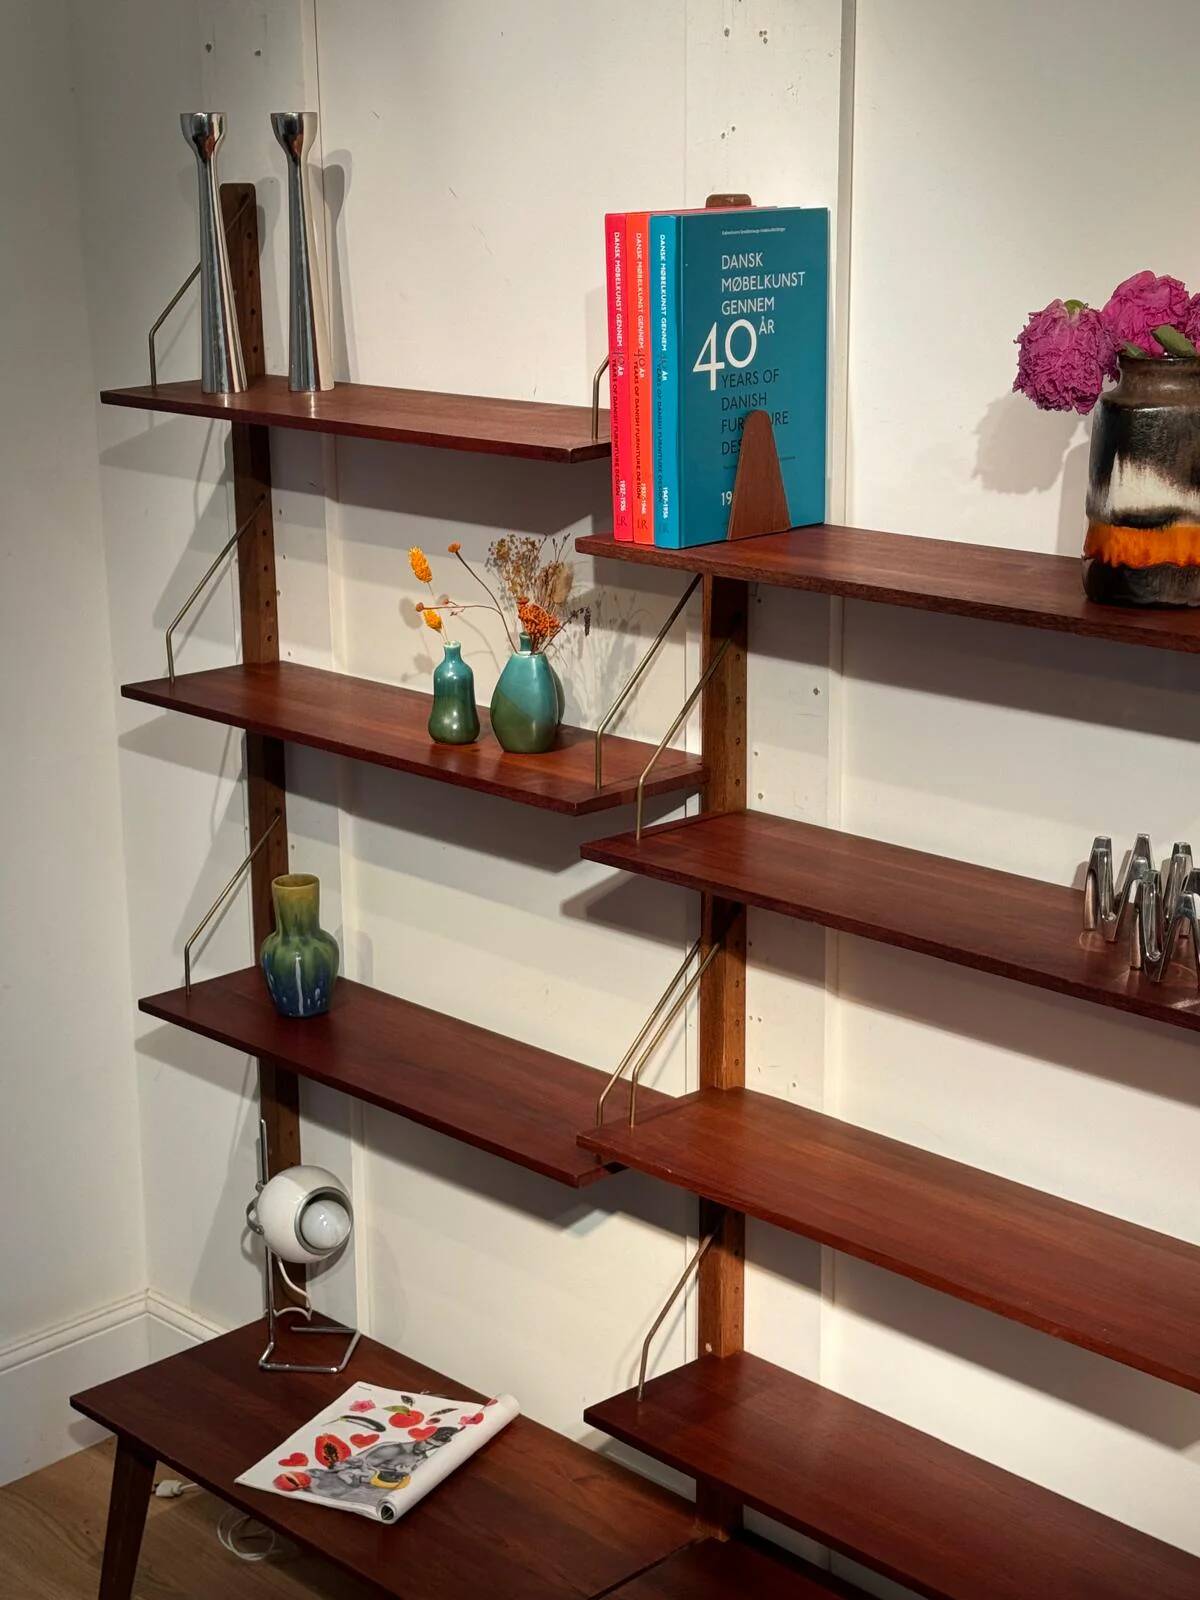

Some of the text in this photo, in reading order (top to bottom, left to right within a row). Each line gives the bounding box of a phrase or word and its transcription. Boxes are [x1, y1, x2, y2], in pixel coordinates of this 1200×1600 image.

[721, 252, 763, 270] DANSK
[721, 271, 806, 293] MØBELKUNST
[721, 296, 775, 316] GENNEM
[692, 315, 775, 391] 40 ÅR
[721, 368, 780, 389] YEARS OF
[721, 391, 767, 412] DANISH
[721, 410, 789, 434] FURURE
